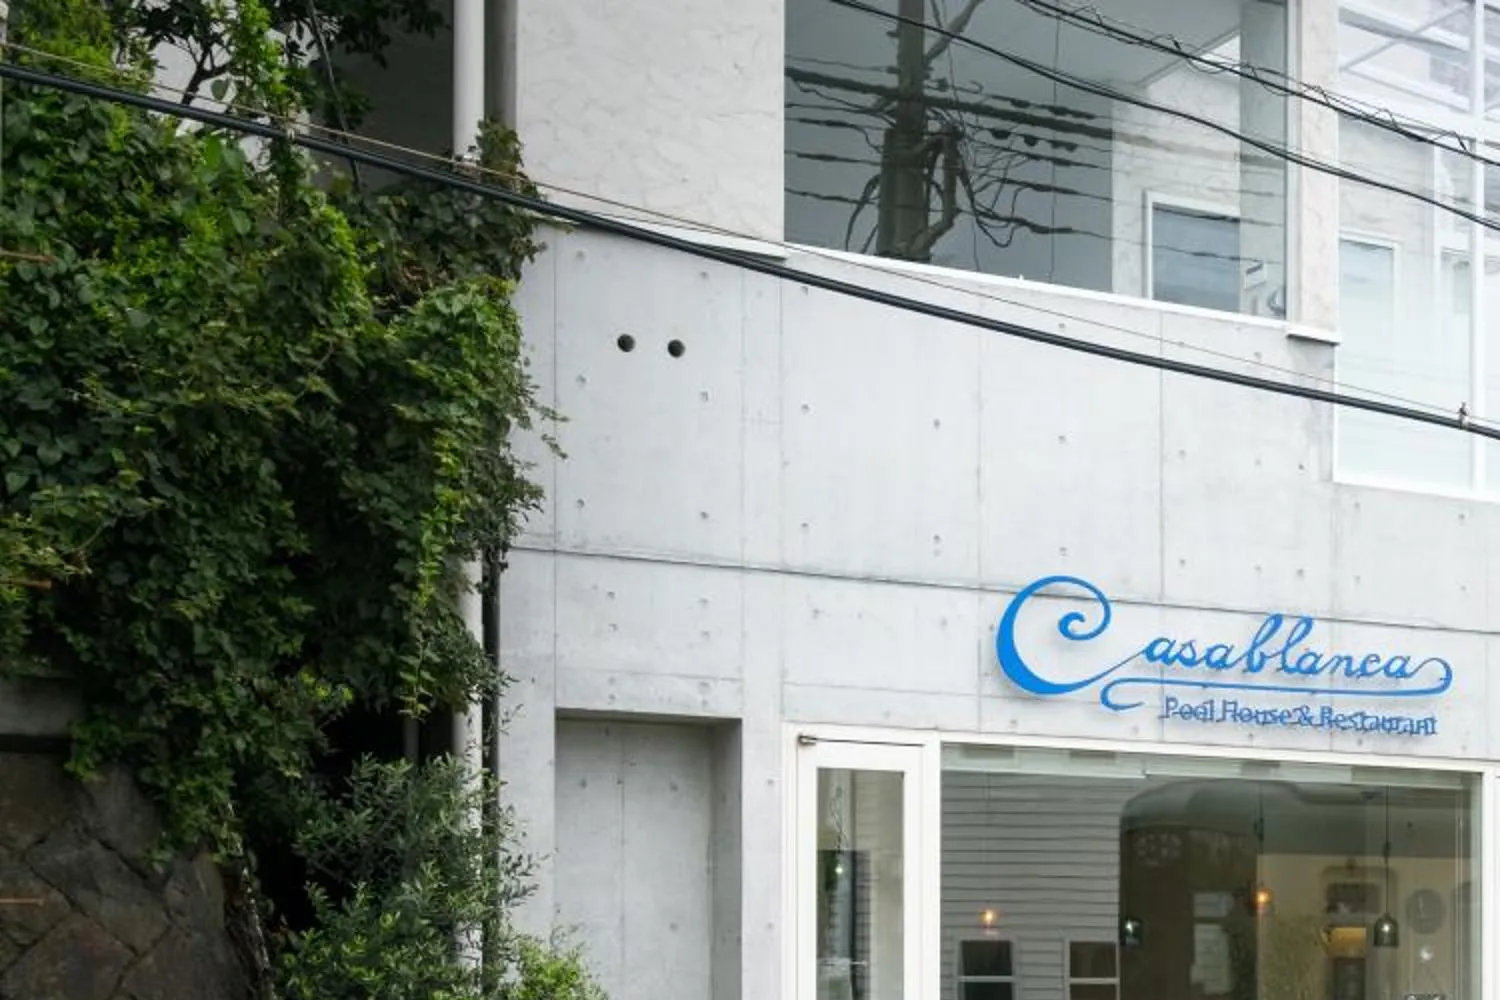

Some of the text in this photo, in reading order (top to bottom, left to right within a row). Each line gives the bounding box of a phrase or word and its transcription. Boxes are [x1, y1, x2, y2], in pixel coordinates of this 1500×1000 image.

[995, 574, 1454, 700] Casablanca
[1164, 696, 1437, 736] Pool House & Restaurant
